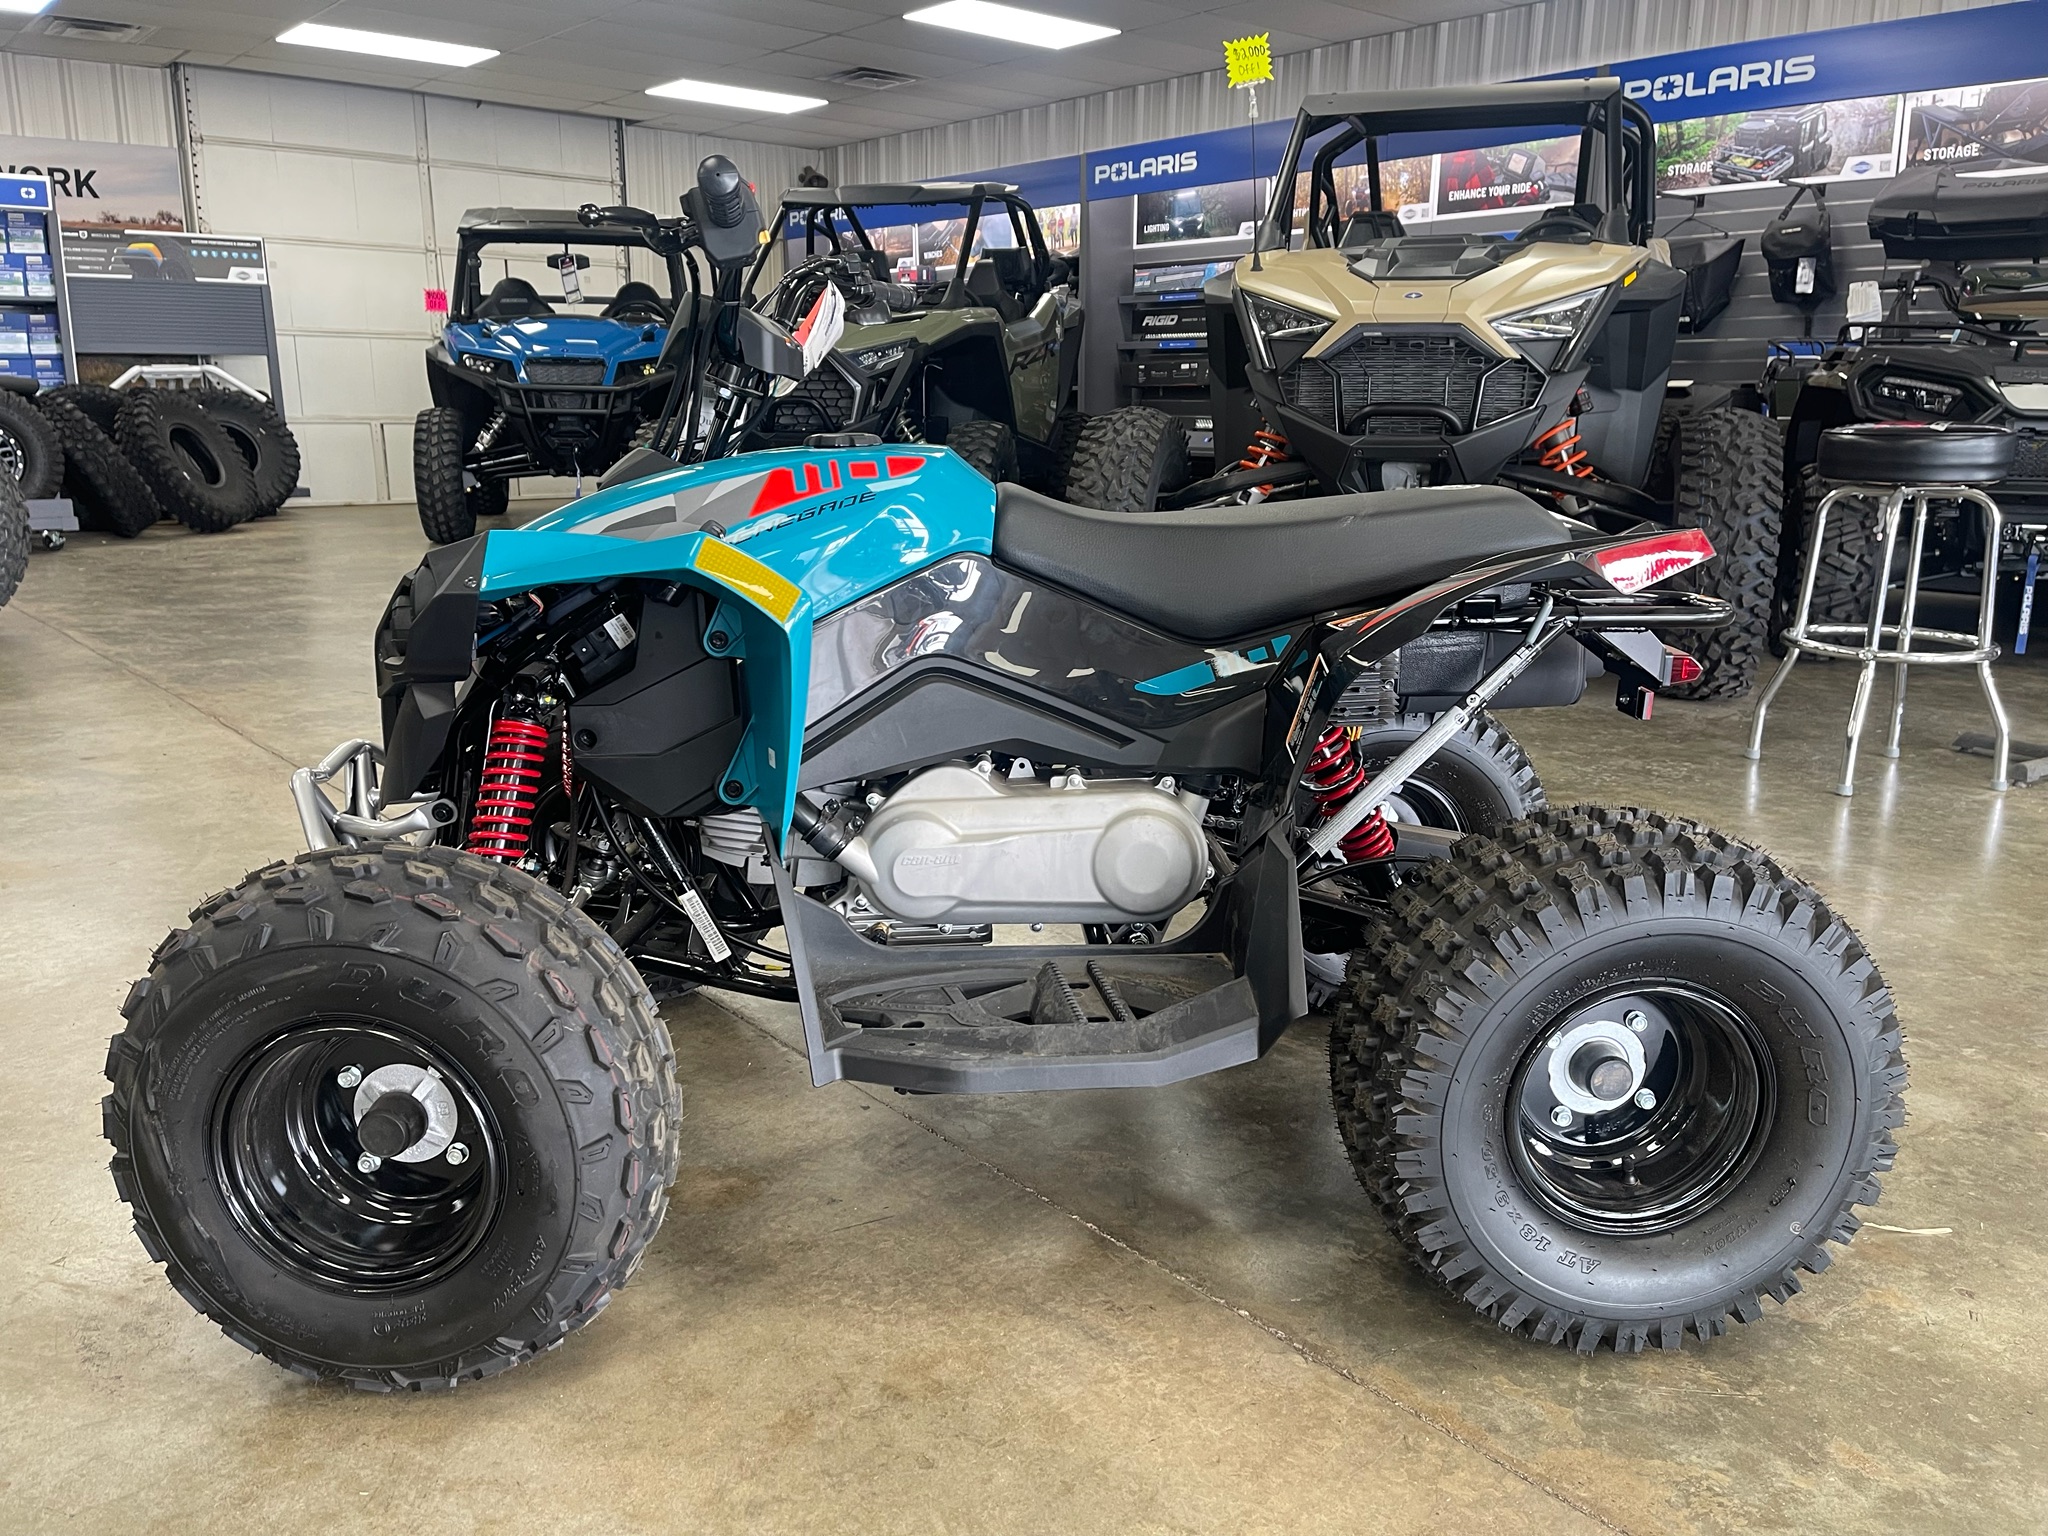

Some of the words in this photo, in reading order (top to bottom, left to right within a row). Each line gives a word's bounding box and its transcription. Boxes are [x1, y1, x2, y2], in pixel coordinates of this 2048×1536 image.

[1623, 54, 1816, 102] POLARIS
[1923, 142, 1981, 161] STORAGE
[1094, 150, 1198, 185] POLARIS
[1667, 161, 1715, 177] STORAGE
[1448, 186, 1487, 202] ENHANCE
[1488, 184, 1511, 197] YOUR
[1511, 181, 1532, 194] RIDE
[1143, 222, 1170, 235] LIGHTING
[1142, 314, 1179, 327] RIGID
[2019, 585, 2034, 636] POLARIS
[1557, 1250, 1601, 1275] AT
